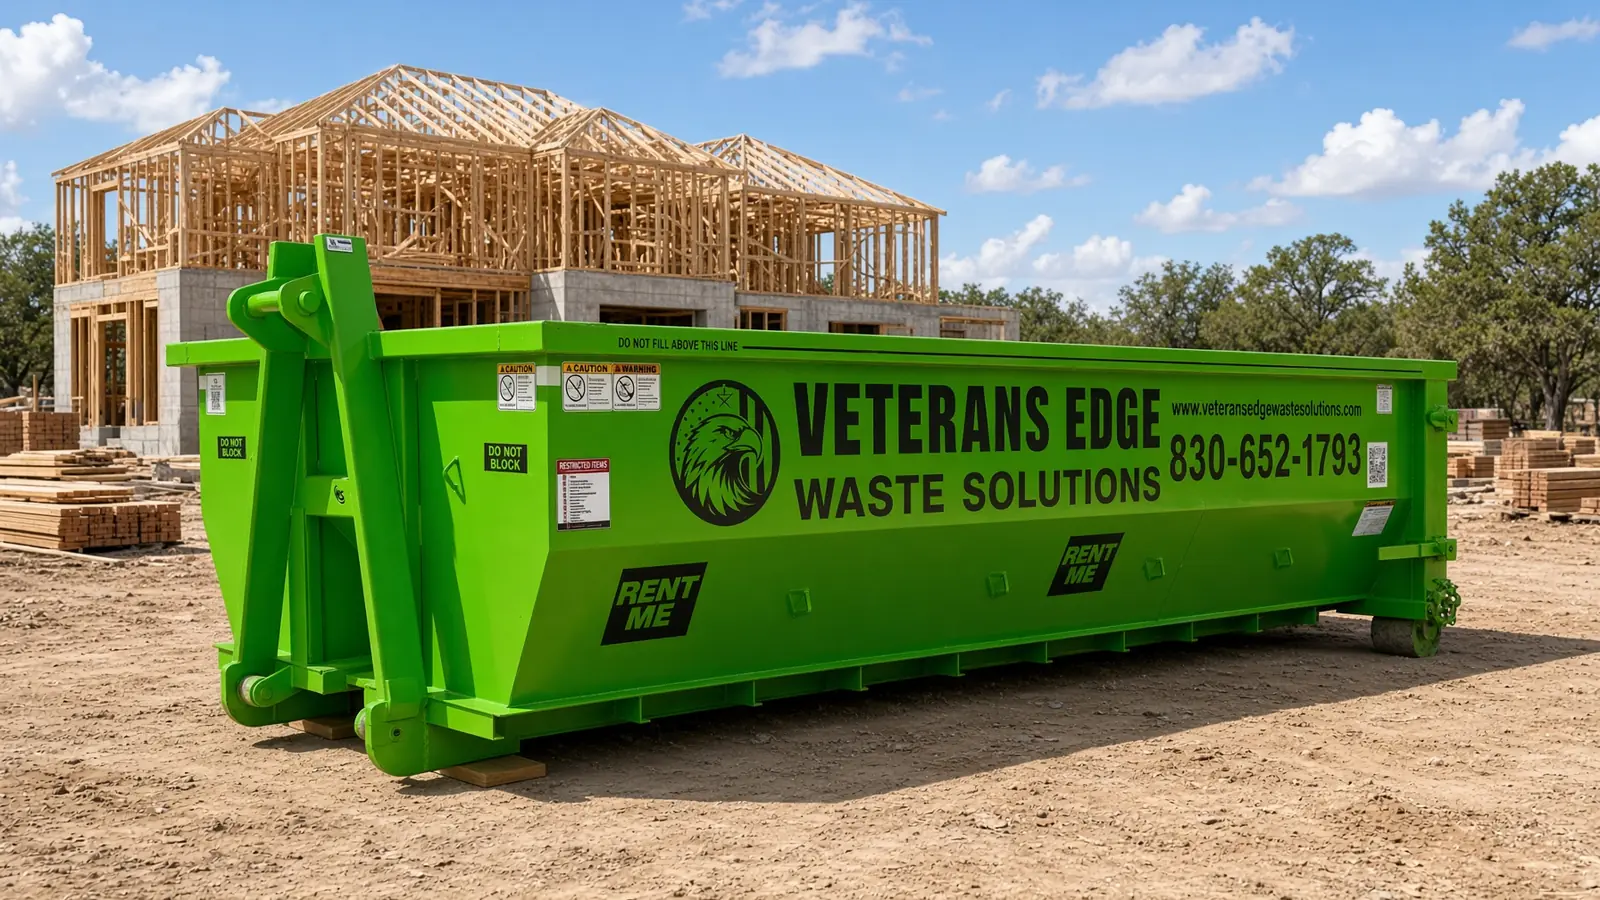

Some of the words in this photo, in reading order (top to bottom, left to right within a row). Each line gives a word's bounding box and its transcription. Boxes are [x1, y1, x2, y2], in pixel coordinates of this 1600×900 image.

[618, 337, 631, 348] DO
[633, 338, 650, 348] NOT
[652, 339, 669, 349] FILL
[671, 339, 699, 350] ABOVE
[701, 340, 718, 351] THIS
[721, 341, 738, 351] LINE
[505, 364, 533, 373] CAUTION
[574, 364, 608, 373] CAUTION
[622, 364, 657, 373] WARNING
[1172, 400, 1362, 420] www.veteransedgewastesolutions.com
[794, 382, 1050, 456] VETERANS
[1066, 387, 1161, 450] EDGE
[220, 438, 230, 447] DO
[230, 438, 243, 447] NOT
[222, 448, 242, 457] BLOCK
[488, 445, 501, 456] DO
[503, 446, 522, 457] NOT
[1170, 433, 1362, 482] 830-652-1793
[490, 458, 520, 470] BLOCK
[560, 461, 591, 470] RESTRICTED
[592, 460, 608, 469] ITEMS
[794, 473, 944, 520] WASTE
[963, 466, 1161, 512] SOLUTIONS
[1061, 543, 1119, 566] RENT
[1064, 564, 1099, 585] ME
[615, 575, 701, 606] RENT
[624, 603, 675, 631] ME
